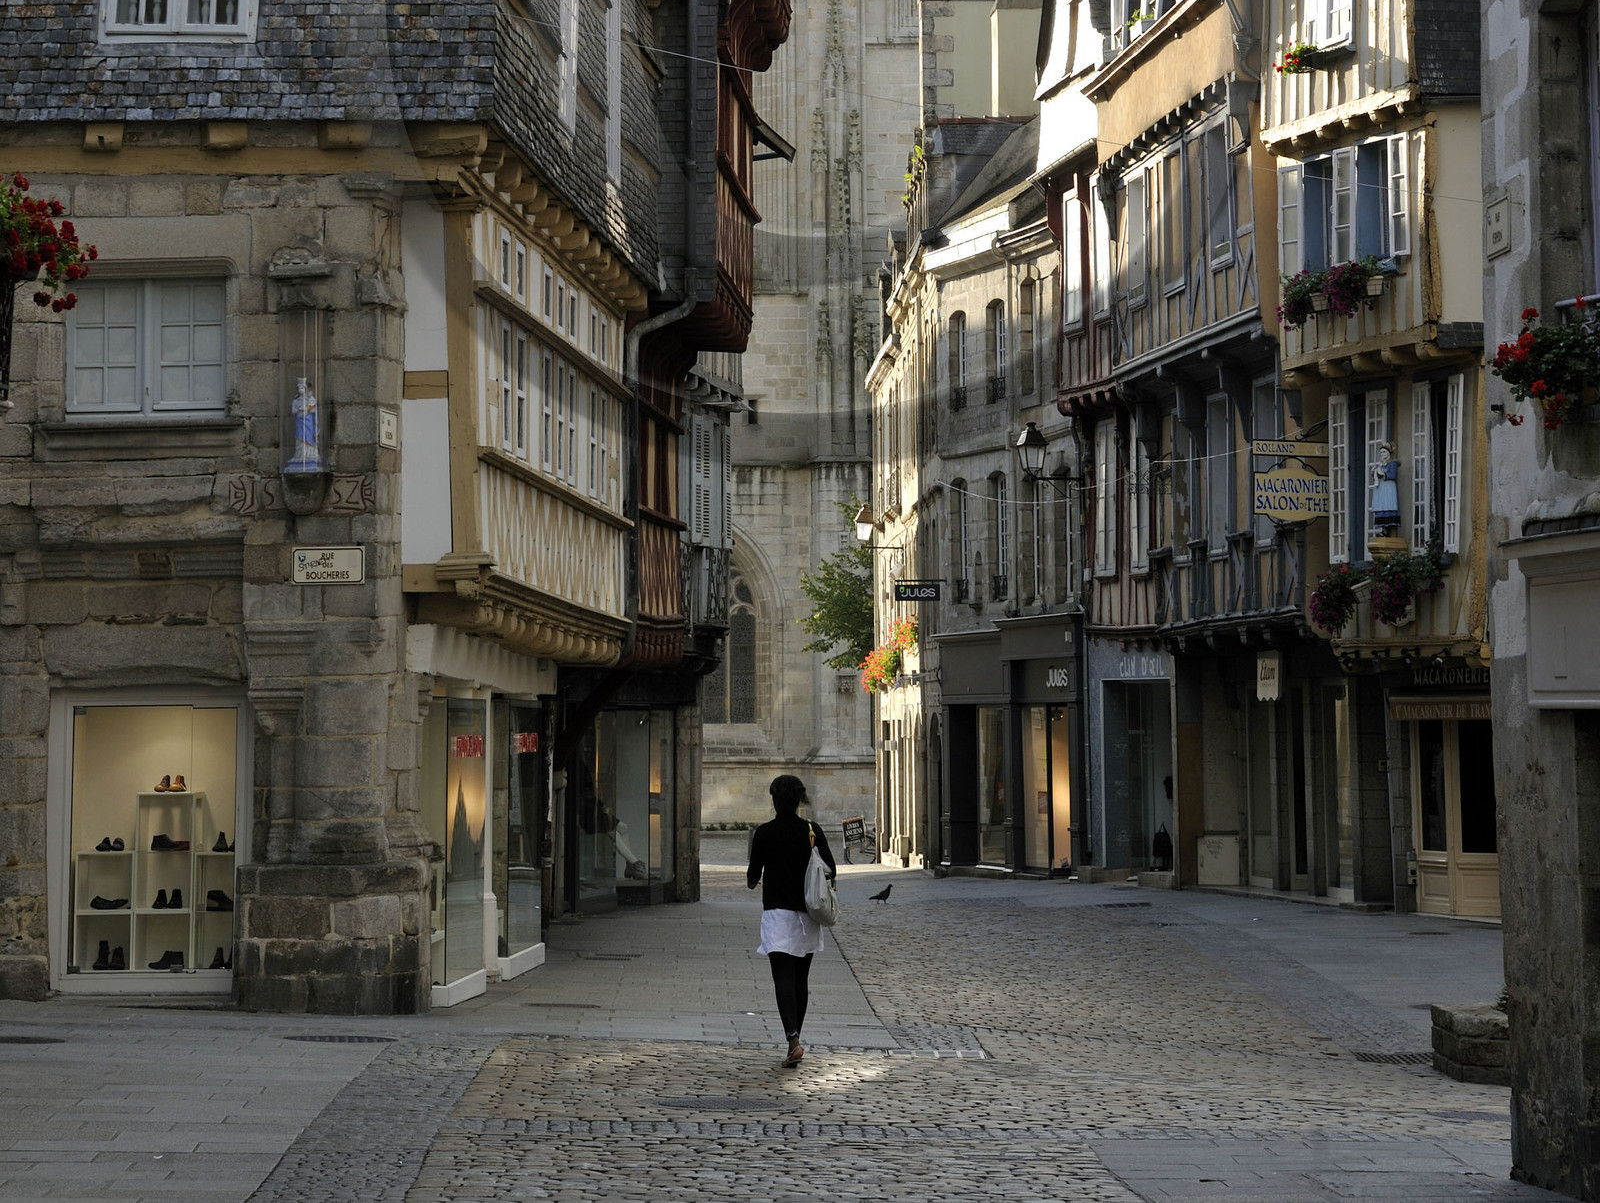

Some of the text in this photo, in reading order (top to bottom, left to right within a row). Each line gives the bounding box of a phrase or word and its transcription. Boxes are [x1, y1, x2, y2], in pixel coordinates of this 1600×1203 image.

[1255, 442, 1296, 454] ROLLAND
[1255, 477, 1329, 494] MACARONIER
[1255, 494, 1300, 511] SALON
[321, 552, 335, 560] RUE
[305, 570, 350, 580] BOUCHERIES
[1413, 667, 1489, 685] MACARONERIE
[1403, 704, 1453, 719] MACARONIER
[1456, 703, 1466, 717] DE
